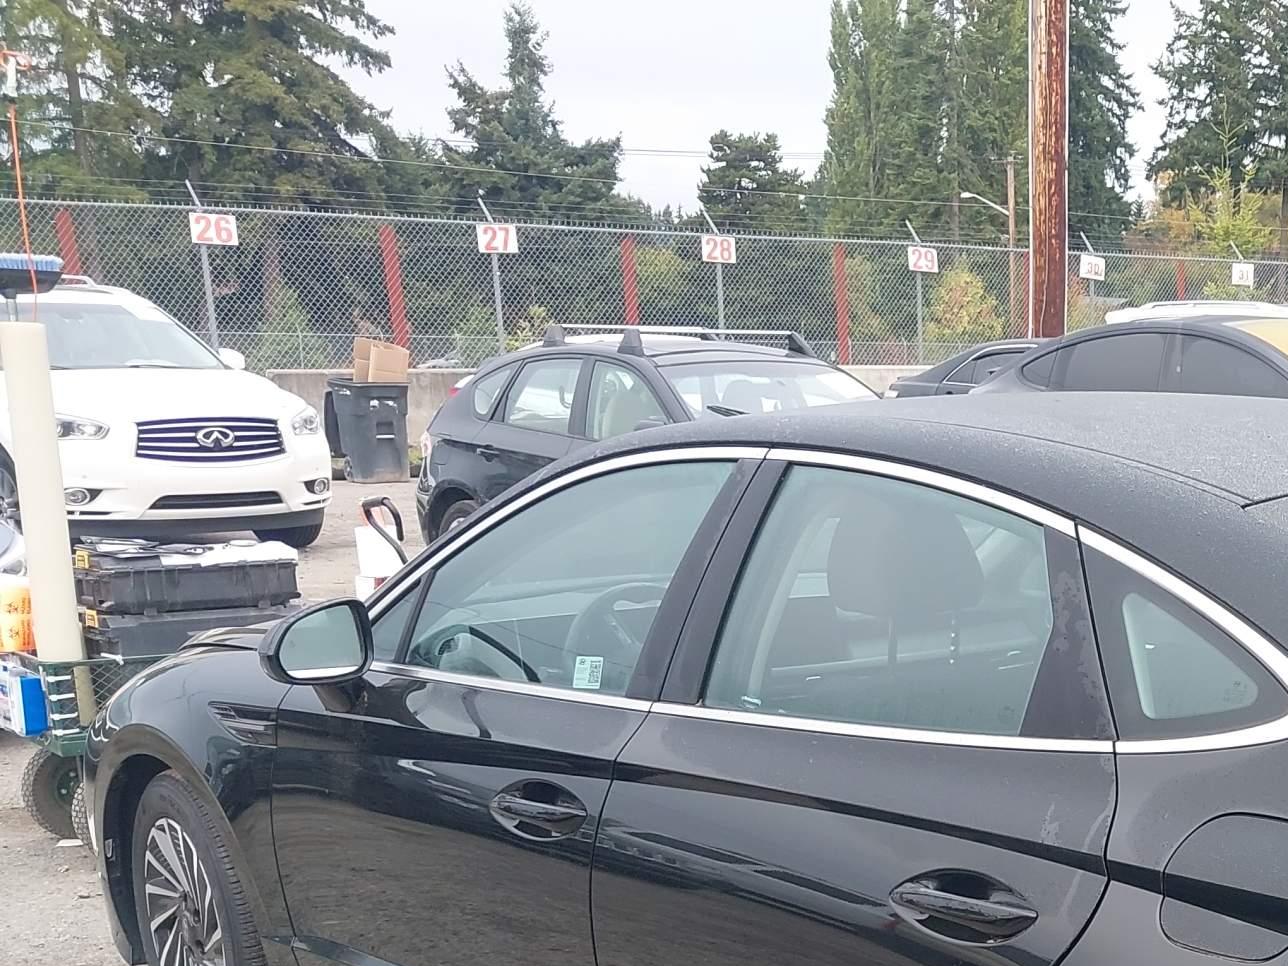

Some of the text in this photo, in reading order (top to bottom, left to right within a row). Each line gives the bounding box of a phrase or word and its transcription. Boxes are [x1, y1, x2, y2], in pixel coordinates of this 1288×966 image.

[194, 215, 233, 243] 26
[482, 226, 510, 252] 27
[705, 237, 732, 261] 28
[911, 248, 935, 270] 29
